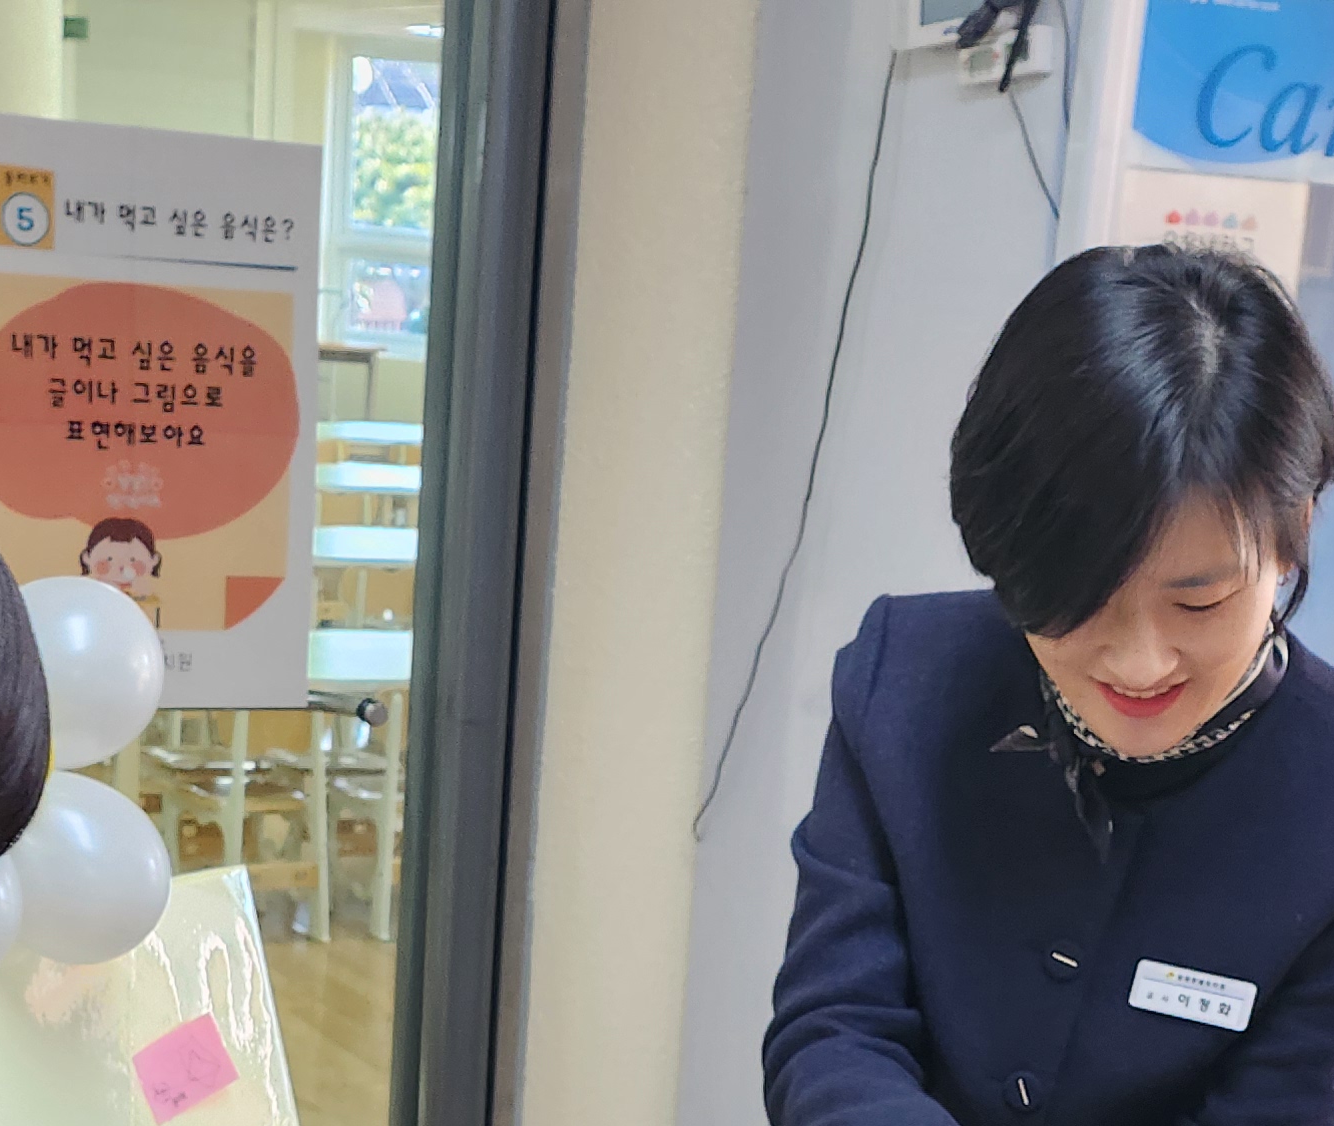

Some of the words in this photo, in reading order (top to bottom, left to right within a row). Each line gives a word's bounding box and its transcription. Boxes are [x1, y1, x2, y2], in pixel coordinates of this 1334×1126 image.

[17, 206, 34, 231] 5
[65, 199, 105, 224] 내가
[119, 204, 157, 232] 먹고
[170, 209, 208, 237] 싶은
[220, 211, 294, 243] 음식은?
[11, 334, 58, 360] 내가
[72, 336, 116, 367] 먹고
[132, 341, 176, 371] 싶은
[192, 343, 257, 377] 음식을
[48, 378, 118, 408] 글이나
[130, 382, 223, 412] 그림으로
[66, 420, 205, 450] 표현해보아요
